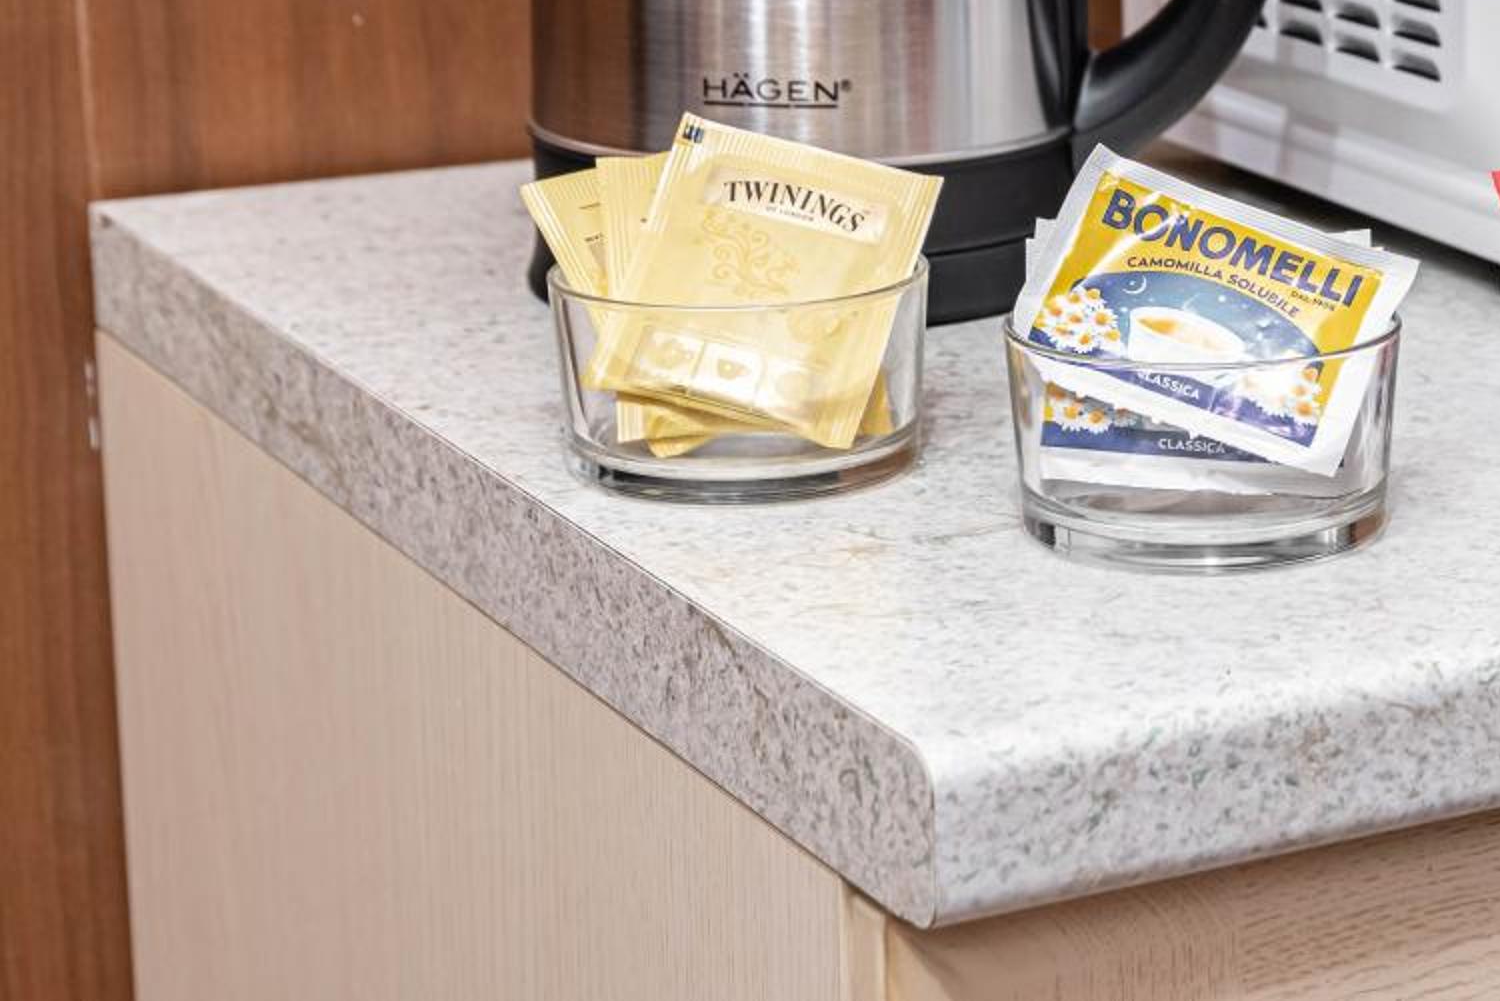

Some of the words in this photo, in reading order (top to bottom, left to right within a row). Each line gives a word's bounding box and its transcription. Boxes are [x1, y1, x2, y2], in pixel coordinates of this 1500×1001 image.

[723, 180, 866, 232] TWININGS
[1101, 188, 1365, 307] BONOMELLI
[1126, 255, 1224, 281] CAMOMILLA
[1228, 274, 1300, 318] SOLUBILE
[1137, 370, 1201, 400] CLASSICA
[1157, 437, 1226, 455] CLASSICA
